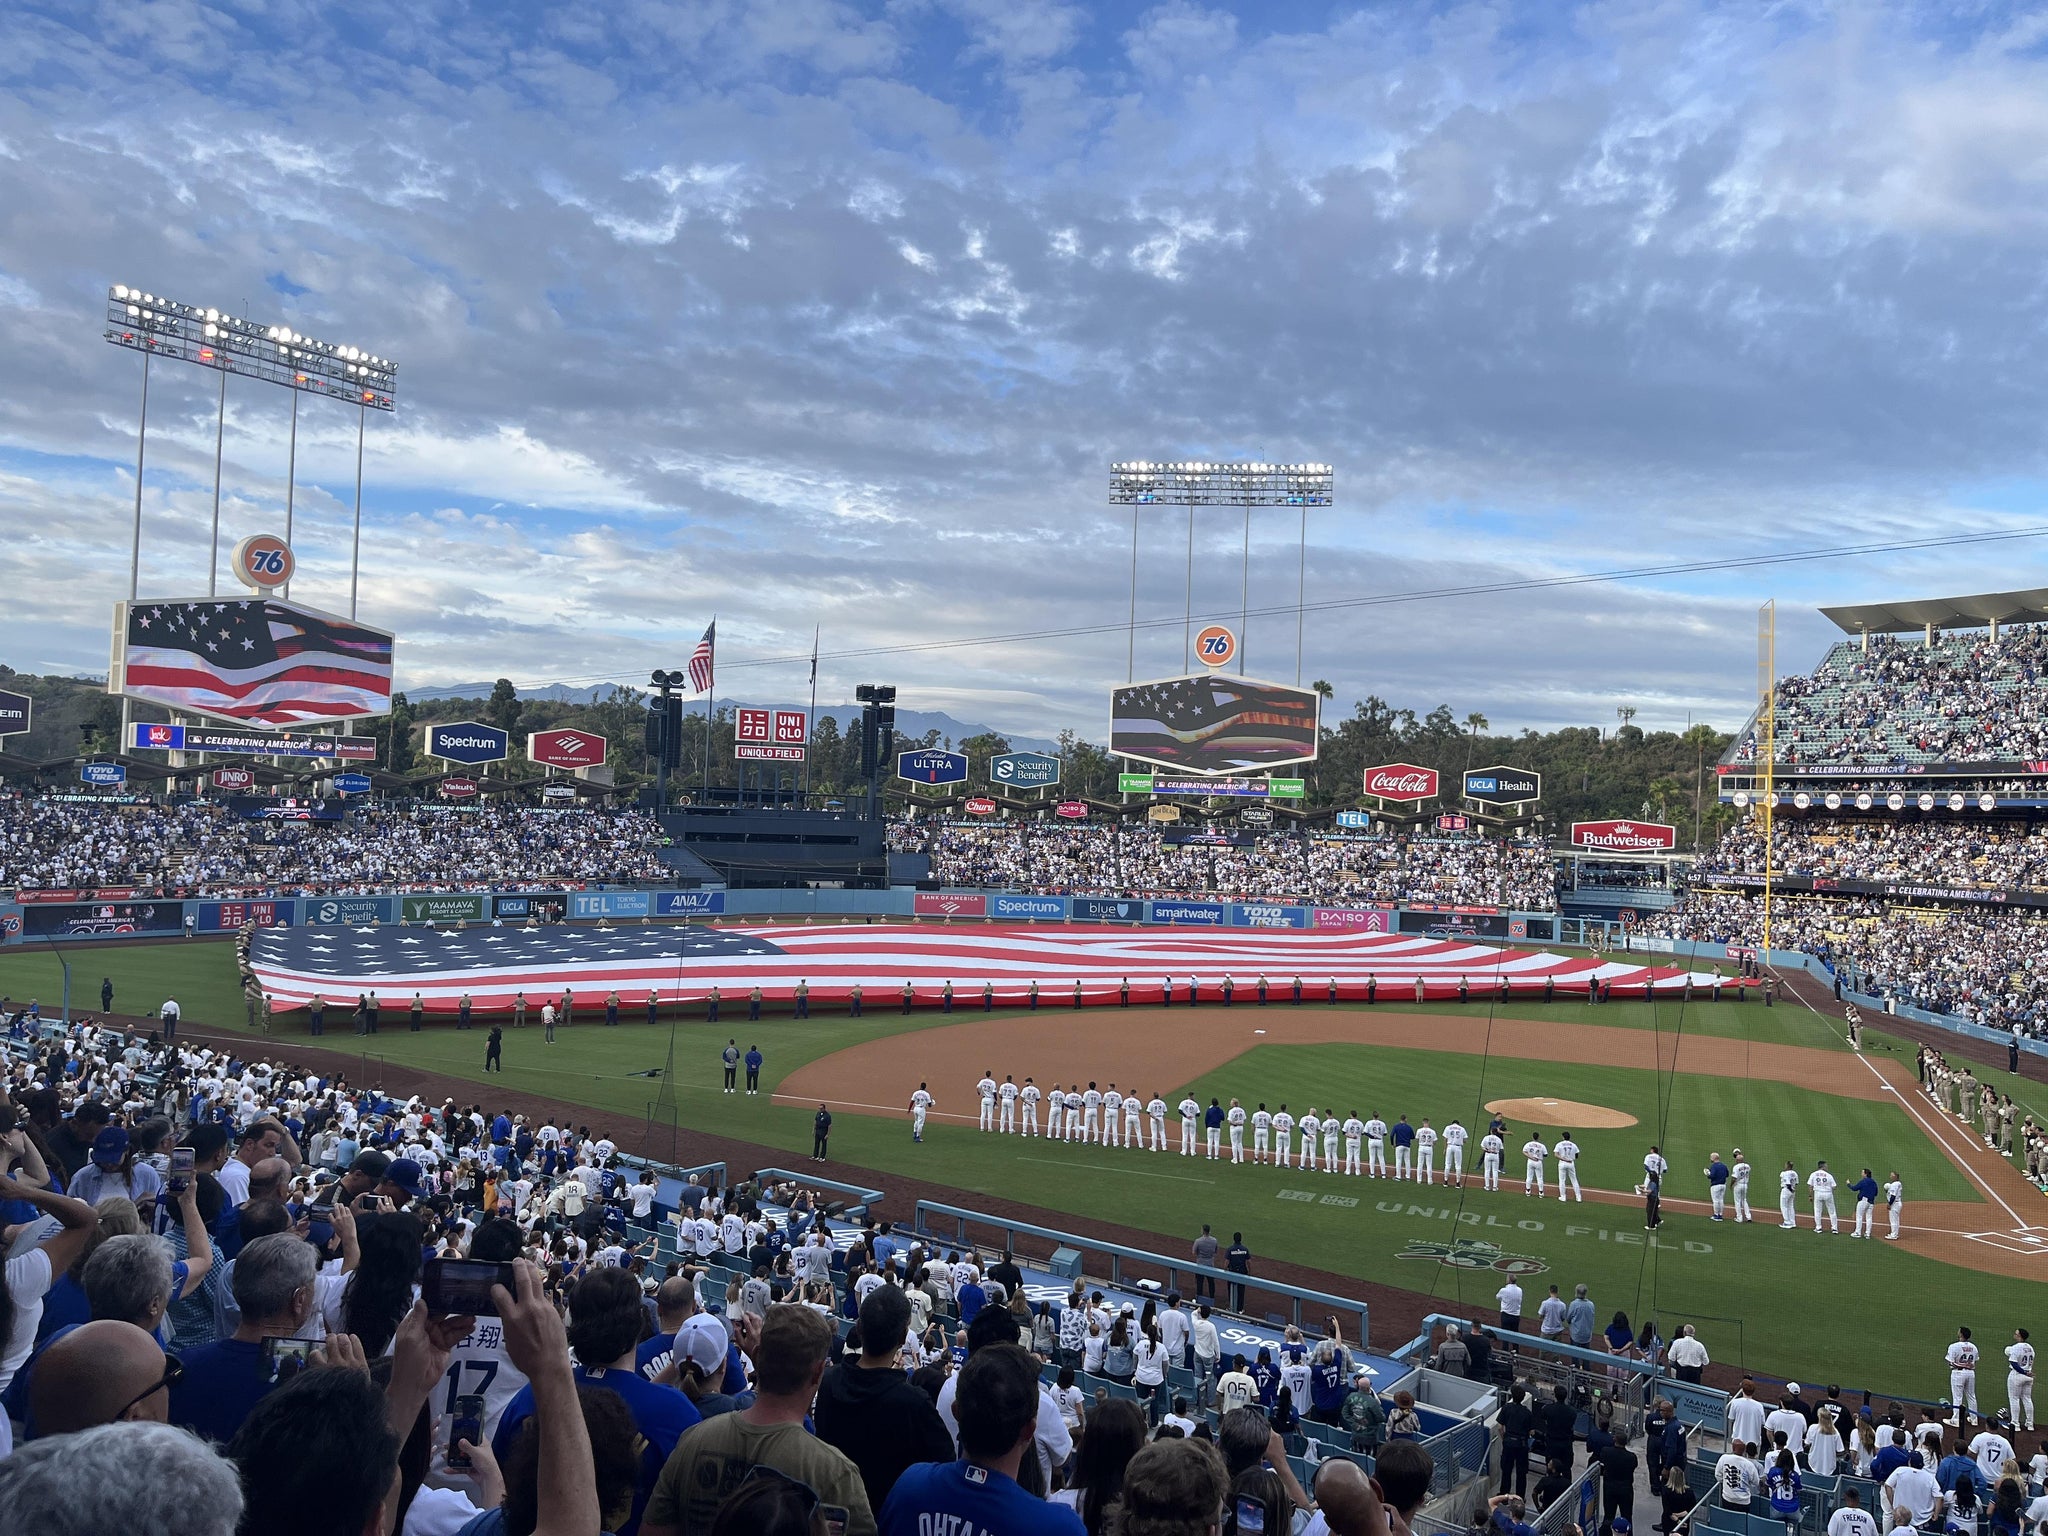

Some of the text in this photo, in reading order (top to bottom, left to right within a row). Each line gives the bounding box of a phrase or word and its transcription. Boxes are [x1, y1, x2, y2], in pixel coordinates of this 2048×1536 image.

[252, 550, 285, 575] 76
[1203, 635, 1228, 655] 76
[779, 716, 800, 727] UNI
[779, 728, 802, 739] QLO
[205, 736, 264, 749] CELEBRATING
[439, 734, 496, 749] Spectrum
[741, 748, 801, 759] UNIQLO FIELD
[914, 759, 953, 769] ULTRA
[1017, 761, 1053, 772] Security
[1808, 765, 1861, 774] CELEBRATING
[220, 771, 249, 784] JINRO
[1017, 771, 1048, 780] Benefit
[444, 783, 475, 791] Yakult
[1167, 781, 1211, 790] CELEBRATING
[1371, 772, 1431, 792] Coca-Cola
[1469, 780, 1493, 789] UCLA
[1499, 780, 1534, 791] Health
[966, 801, 995, 812] Churu
[1340, 814, 1365, 825] TEL
[1687, 874, 1702, 882] 6:57
[1898, 886, 1948, 897] CELEBRATING
[577, 897, 611, 913] TEL
[617, 902, 647, 910] ELECTRON
[671, 895, 698, 906] ANA
[998, 899, 1055, 913] Spectrum
[342, 901, 378, 912] Security
[502, 902, 524, 911] UCLA
[1089, 902, 1116, 913] blue
[1242, 906, 1283, 917] TOYO
[1155, 907, 1220, 919] smartwater
[1321, 911, 1364, 922] DAISO
[1621, 912, 1634, 923] 76
[1249, 917, 1292, 927] TIRES
[1511, 924, 1524, 933] 76
[543, 1131, 550, 1140] 13
[480, 1151, 488, 1161] 13
[598, 1149, 609, 1158] 22
[568, 1184, 579, 1194] 18
[725, 1225, 733, 1236] 17
[1375, 1201, 1713, 1253] UNIQLO FIELD
[606, 1258, 616, 1268] 17
[797, 1257, 807, 1268] 13
[957, 1271, 968, 1285] 22
[748, 1291, 754, 1304] 5
[446, 1360, 499, 1414] 17
[1258, 1375, 1269, 1388] 17
[1293, 1379, 1304, 1393] 17
[1326, 1374, 1338, 1389] 17
[1227, 1381, 1247, 1396] 05
[1060, 1393, 1066, 1405] 5
[1988, 1449, 2001, 1463] 17
[1776, 1484, 1794, 1500] 18
[1843, 1514, 1868, 1525] FREEMAN
[1852, 1525, 1861, 1536] 5
